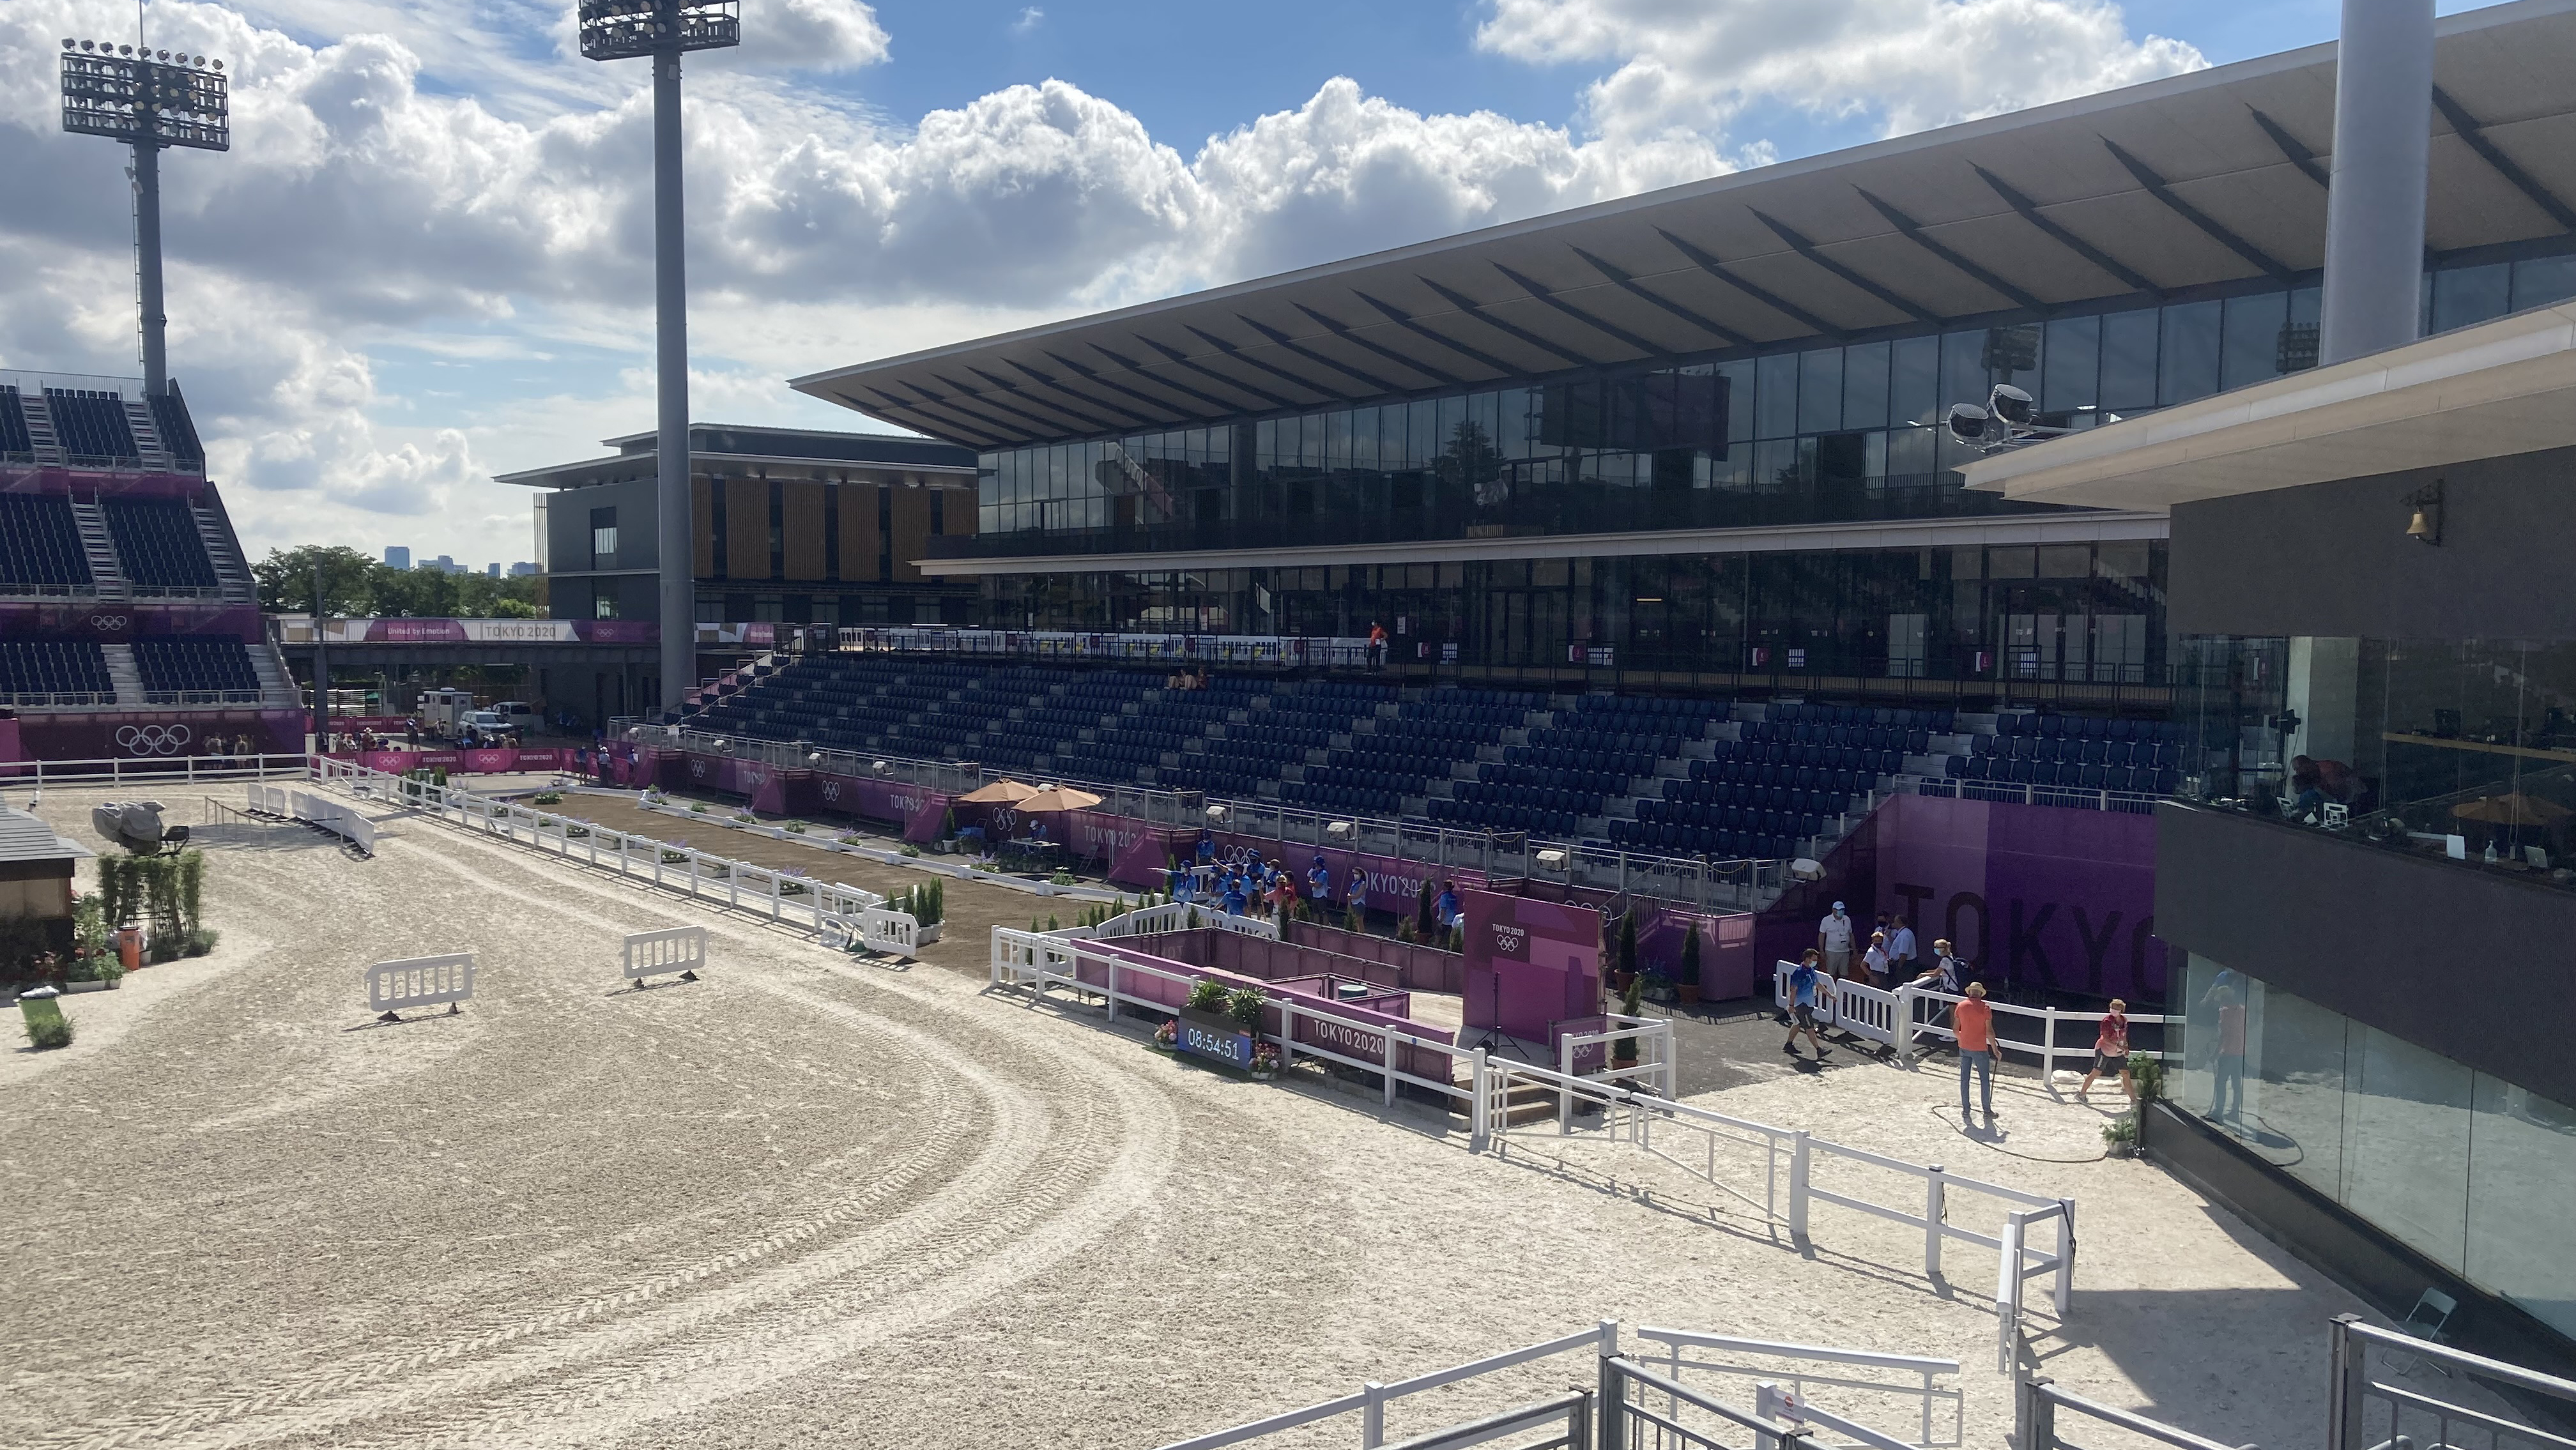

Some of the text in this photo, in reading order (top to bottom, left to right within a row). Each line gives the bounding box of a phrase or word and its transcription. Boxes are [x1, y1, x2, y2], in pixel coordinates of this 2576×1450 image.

[412, 627, 421, 636] by
[485, 626, 556, 637] TOKYO 2020
[1492, 923, 1524, 937] TOKYO 2020
[1187, 1027, 1239, 1060] 08:54:51
[1314, 1019, 1384, 1055] TOKYO 2020
